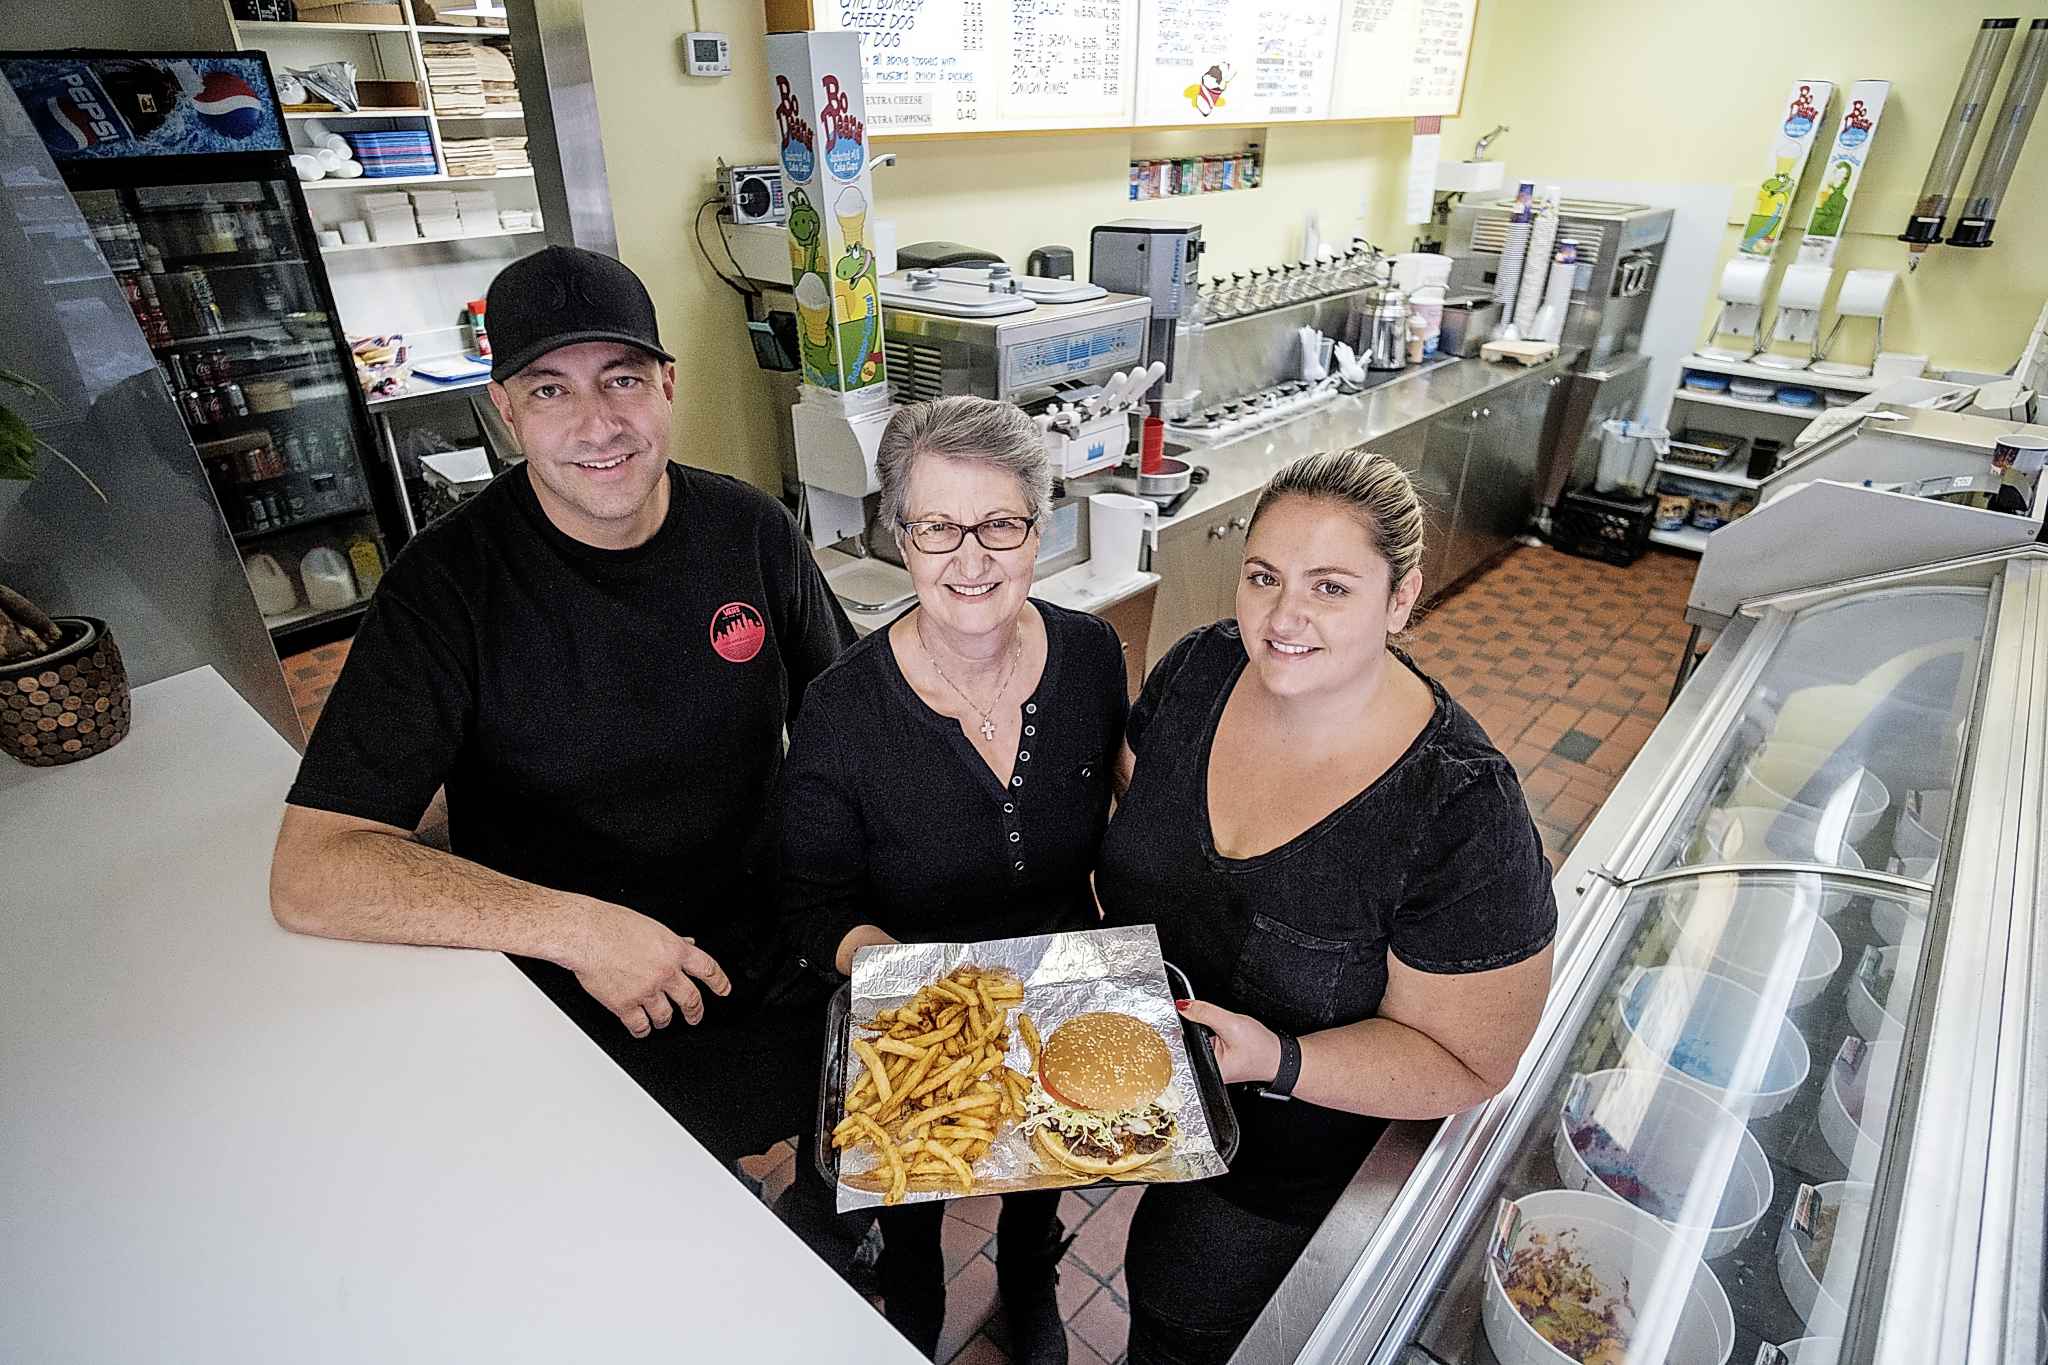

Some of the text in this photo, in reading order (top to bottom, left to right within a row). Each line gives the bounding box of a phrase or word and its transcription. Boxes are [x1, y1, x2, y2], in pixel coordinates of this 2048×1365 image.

[841, 11, 916, 31] CHEESE DOG
[873, 32, 901, 48] DOG
[865, 95, 892, 106] EXTRA
[893, 94, 923, 106] CHEESE
[59, 73, 121, 143] PEPSI
[866, 114, 892, 126] EXTRA
[723, 606, 740, 616] VANS
